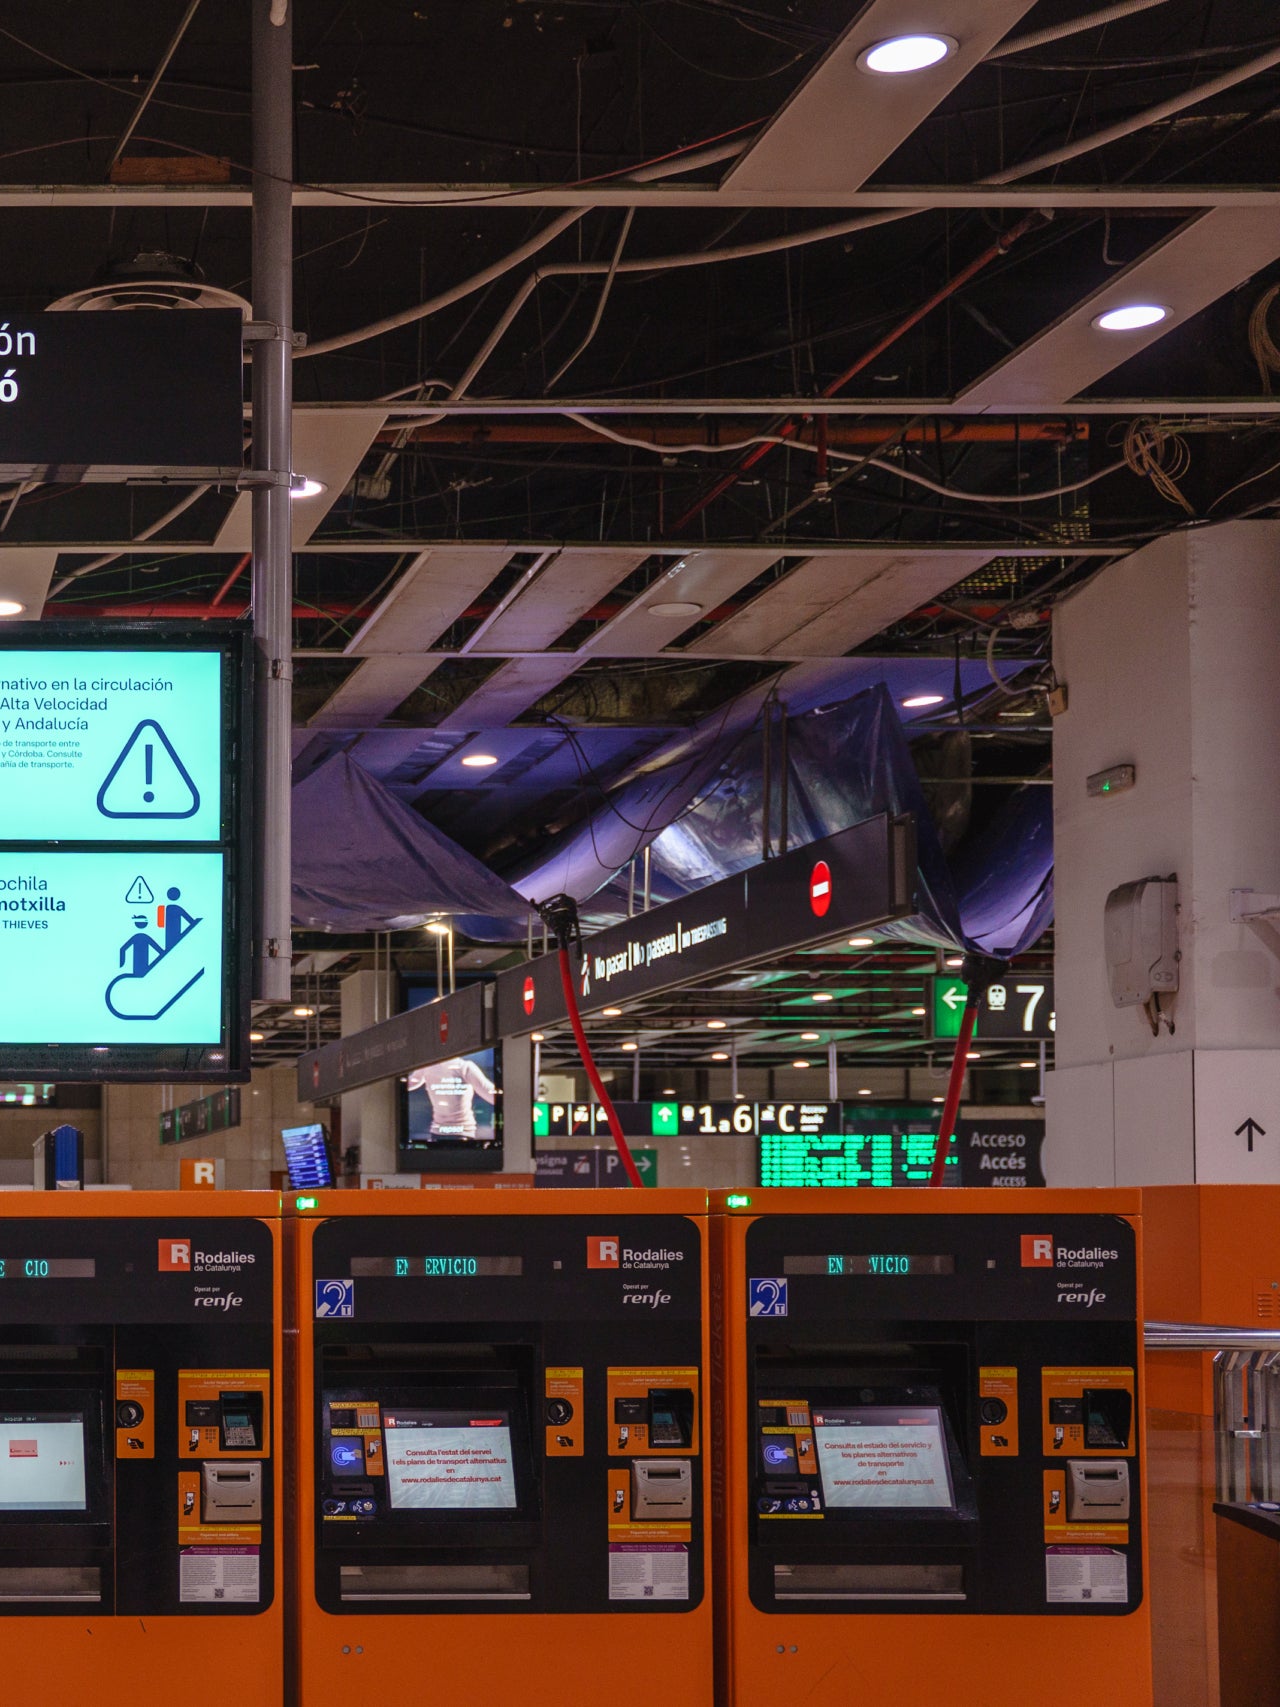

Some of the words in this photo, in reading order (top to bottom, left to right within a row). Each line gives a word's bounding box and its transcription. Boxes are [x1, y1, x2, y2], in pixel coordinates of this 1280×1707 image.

[52, 681, 69, 690] en
[75, 678, 86, 690] la
[92, 678, 172, 691] circulación
[0, 698, 29, 710] Alta
[34, 698, 107, 710] Velocidad
[2, 721, 10, 732] y
[16, 718, 88, 730] Andalucía
[3, 921, 48, 929] THIEVES
[606, 952, 628, 981] pasar
[1016, 985, 1044, 1031] 7
[552, 1105, 564, 1122] P
[778, 1105, 795, 1132] C
[970, 1132, 1026, 1148] Acceso
[980, 1153, 1026, 1170] Accés
[194, 1163, 215, 1184] R
[992, 1176, 1026, 1187] ACCESS
[196, 1252, 255, 1263] Rodalies
[624, 1250, 683, 1260] Rodalies
[1058, 1248, 1118, 1260] Rodalies
[425, 1258, 477, 1275] ERVICIO
[828, 1257, 843, 1274] EN
[195, 1291, 242, 1311] renfe
[624, 1288, 671, 1308] renfe
[1058, 1287, 1106, 1308] renfe
